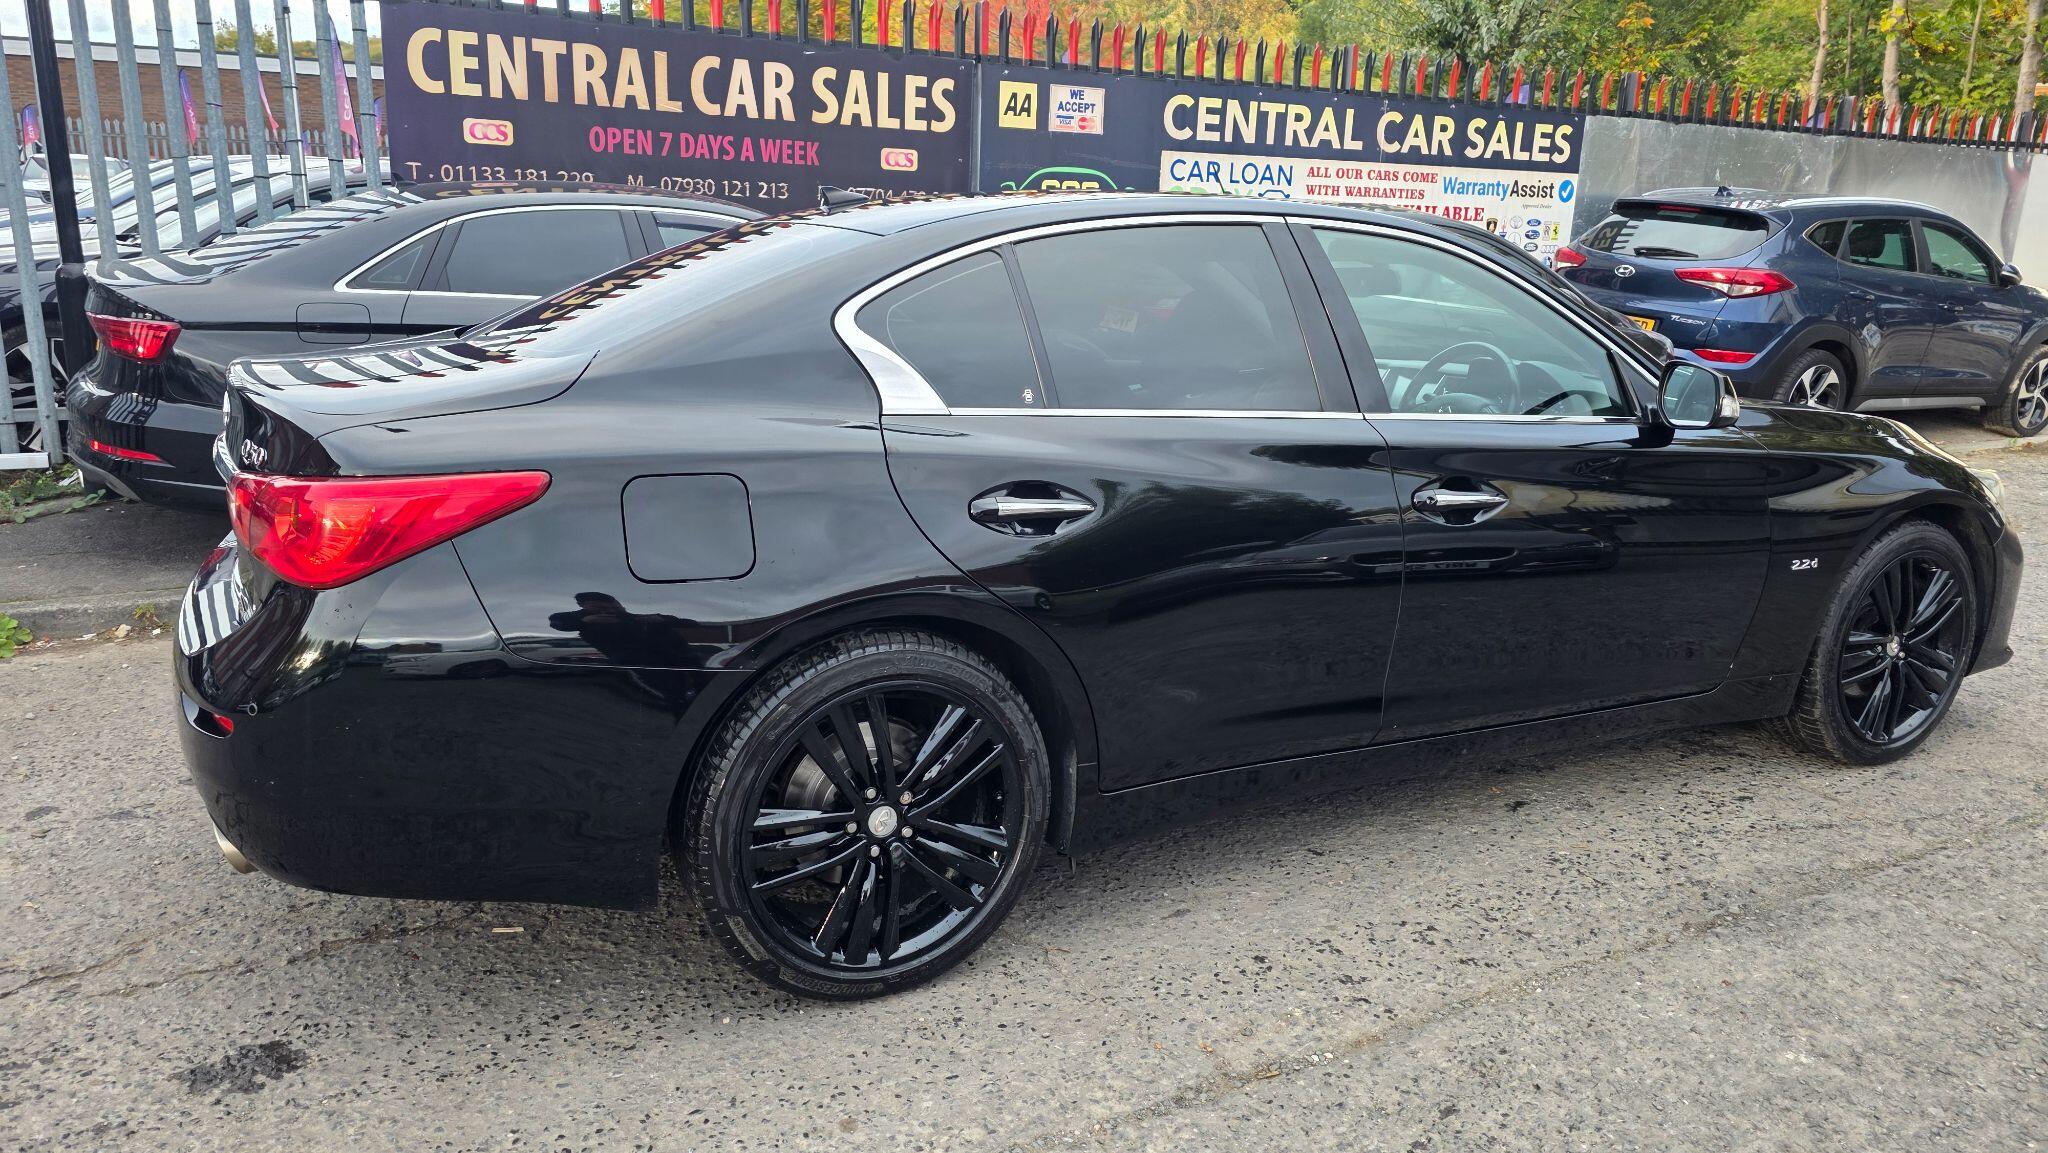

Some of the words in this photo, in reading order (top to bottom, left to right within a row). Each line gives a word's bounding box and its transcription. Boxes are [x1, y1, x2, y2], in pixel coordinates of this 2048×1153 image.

[406, 27, 684, 113] CENTRAL
[690, 55, 796, 122] CAR
[811, 66, 956, 133] SALES
[1004, 92, 1031, 117] AA
[1070, 89, 1085, 101] WE
[1057, 101, 1096, 114] ACCEPT
[1163, 94, 1364, 151] CENTRAL
[1376, 111, 1456, 156] CAR
[1464, 117, 1574, 164] SALES
[589, 125, 653, 156] OPEN
[659, 132, 673, 157] 7
[679, 132, 735, 161] DAYS
[740, 137, 755, 162] A
[759, 138, 820, 166] WEEK
[440, 164, 506, 182] 01133
[1169, 158, 1221, 183] CAR
[1229, 162, 1294, 187] LOAN
[1307, 166, 1331, 178] ALL
[1336, 167, 1363, 180] OUR
[1367, 169, 1399, 182] CARS
[1403, 171, 1438, 184] COME
[661, 176, 716, 195] 07930
[722, 180, 751, 197] 121
[758, 181, 789, 199] 213
[1306, 184, 1340, 197] WITH
[1345, 185, 1425, 200] WARRANTIES
